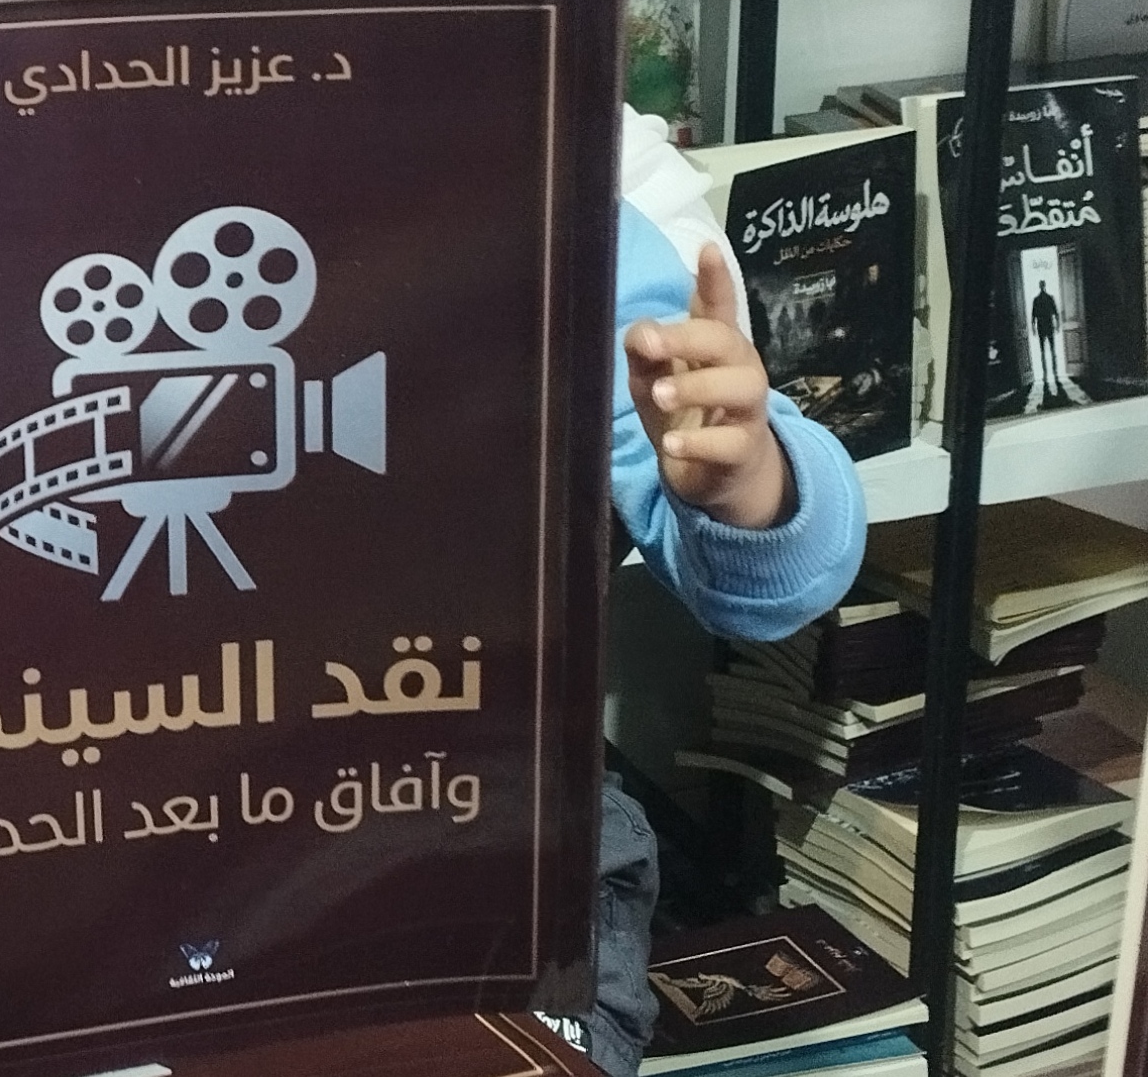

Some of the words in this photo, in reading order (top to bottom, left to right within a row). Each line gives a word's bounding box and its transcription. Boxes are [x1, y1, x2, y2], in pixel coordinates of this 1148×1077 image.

[5, 46, 190, 117] الحدادي
[204, 46, 294, 96] عزيز
[313, 53, 351, 81] د.
[742, 195, 814, 254] الذاكرة
[814, 178, 891, 233] هلوسة
[312, 635, 482, 719] نقد
[123, 794, 219, 843] بعد
[241, 772, 294, 825] ما
[314, 751, 480, 833] وآفاق
